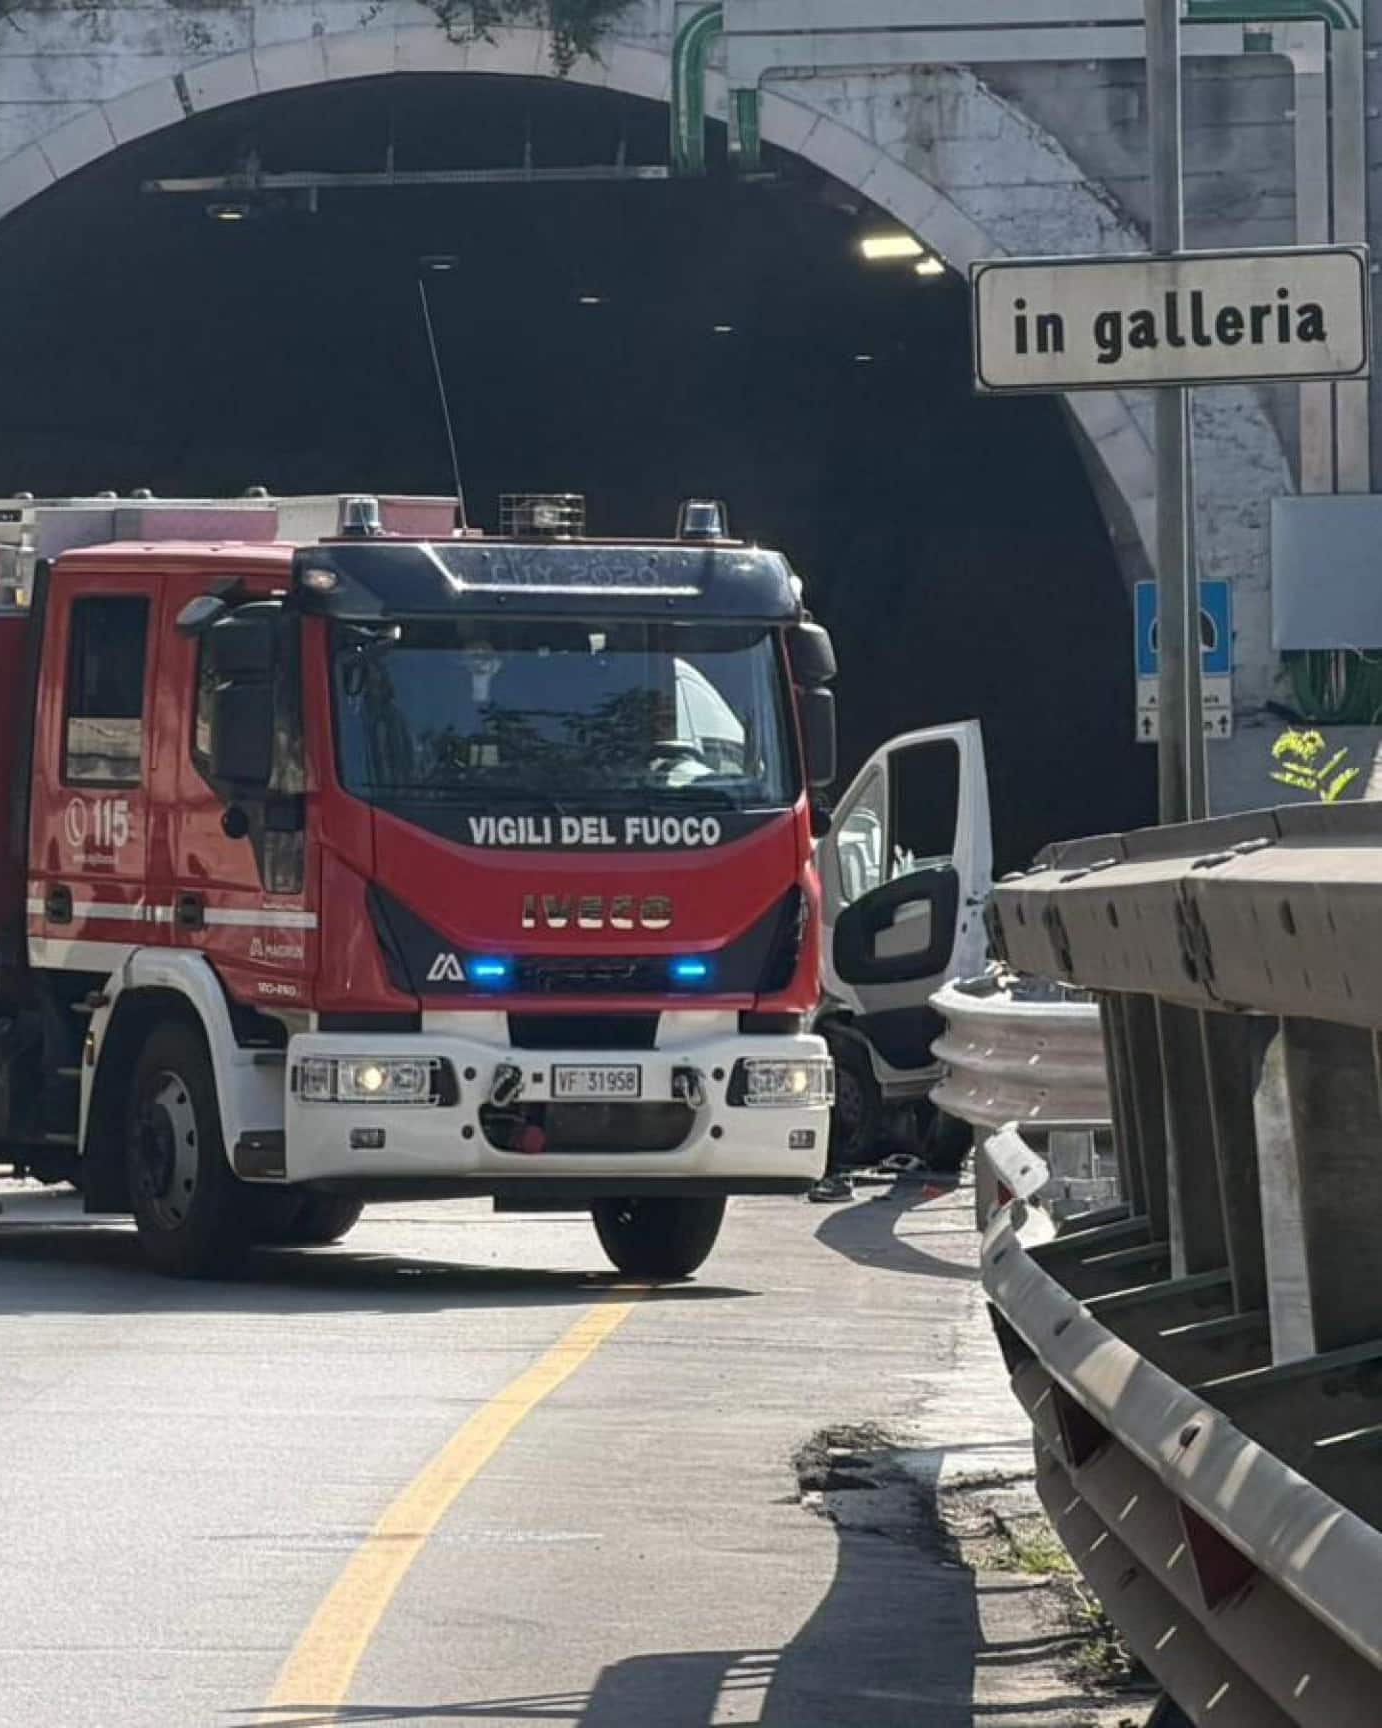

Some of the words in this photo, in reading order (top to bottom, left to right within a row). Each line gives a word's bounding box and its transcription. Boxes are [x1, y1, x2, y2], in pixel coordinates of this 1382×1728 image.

[1014, 298, 1065, 355] in
[1094, 287, 1327, 365] galleria
[92, 798, 130, 848] 115
[469, 816, 551, 846] VIGILI
[561, 816, 616, 845] DEL
[625, 816, 721, 846] FUOCO
[521, 894, 672, 929] IVECO
[558, 1071, 577, 1092] VF
[587, 1071, 635, 1092] 31958
